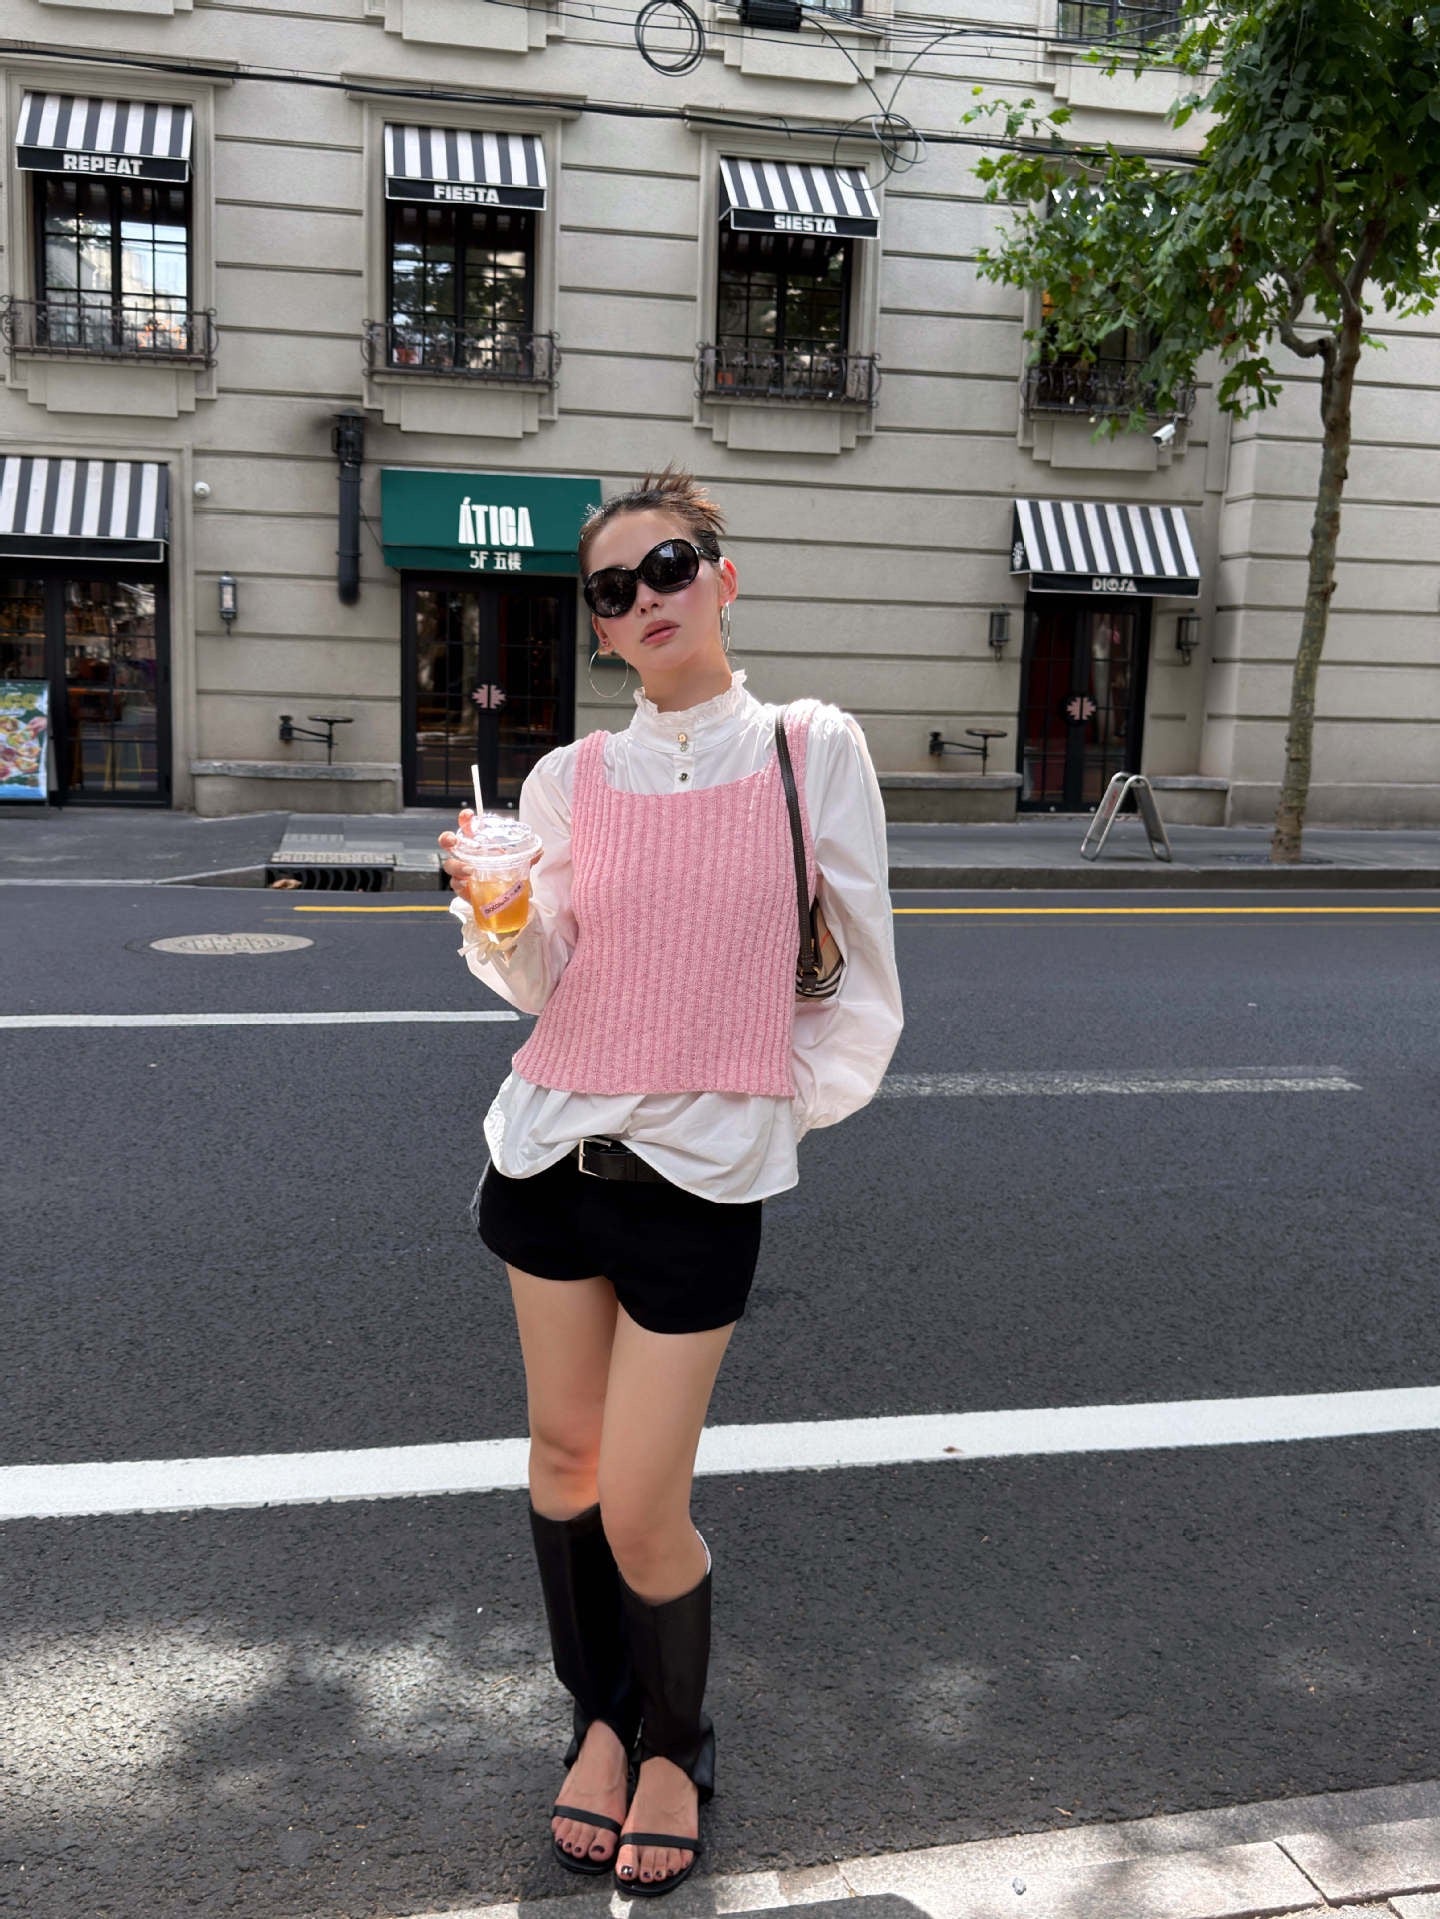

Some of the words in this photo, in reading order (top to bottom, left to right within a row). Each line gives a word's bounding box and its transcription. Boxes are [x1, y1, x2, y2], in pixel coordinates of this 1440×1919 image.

[63, 153, 144, 176] REPEAT
[433, 184, 500, 204] FIESTA
[774, 214, 837, 233] SIESTA
[458, 496, 535, 547] ÁTICA
[469, 550, 489, 569] 5F
[493, 551, 522, 571] 五楼
[1091, 578, 1137, 592] DIOSA
